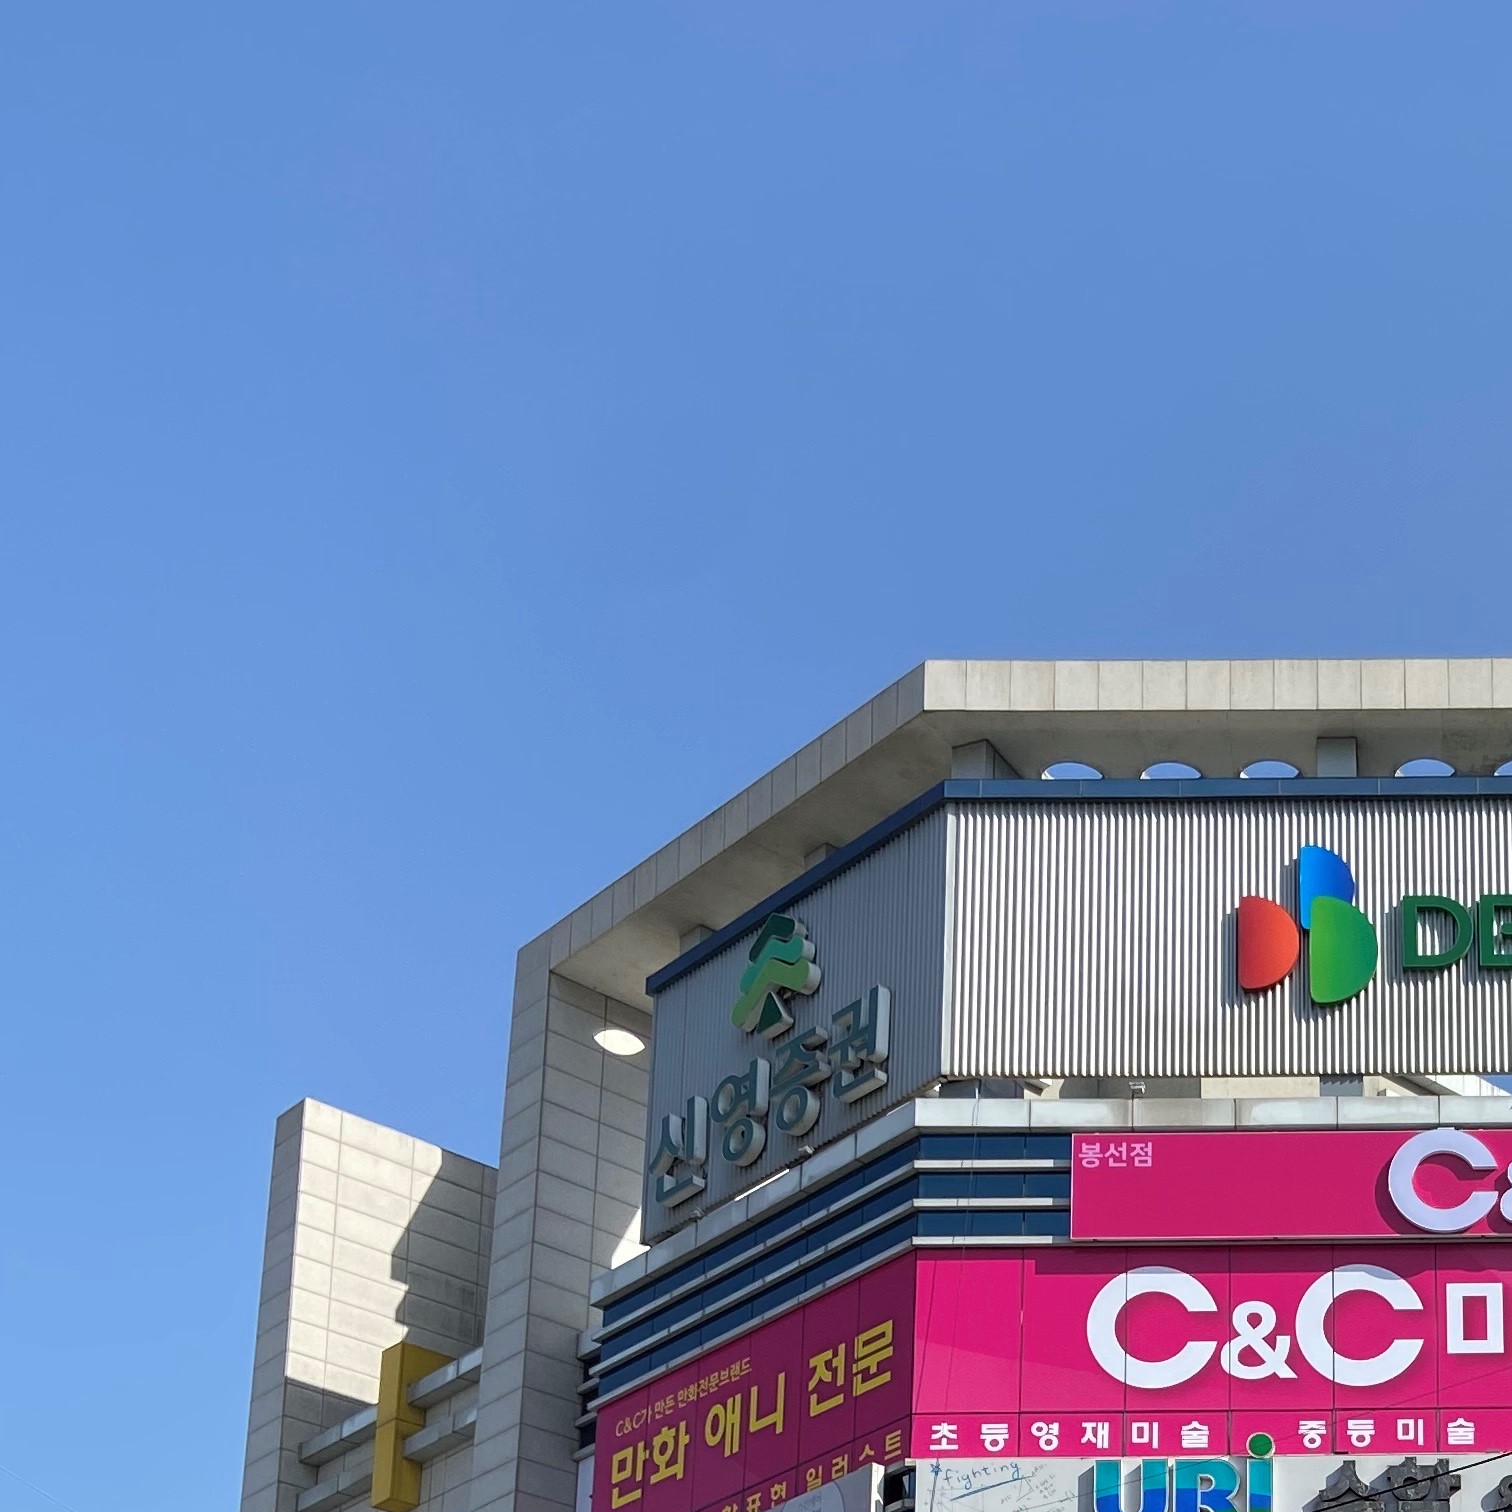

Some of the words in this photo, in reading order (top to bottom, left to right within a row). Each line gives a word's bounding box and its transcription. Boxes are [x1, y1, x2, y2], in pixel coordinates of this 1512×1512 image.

[651, 985, 890, 1207] 신영증권
[1078, 1141, 1153, 1169] 봉선점
[611, 1419, 691, 1510] 만화
[705, 1371, 786, 1457] 애니
[808, 1319, 895, 1418] 전문
[929, 1419, 1210, 1453] 초등영재미술
[1298, 1417, 1476, 1450] 중등미술
[943, 1461, 1020, 1490] fighting
